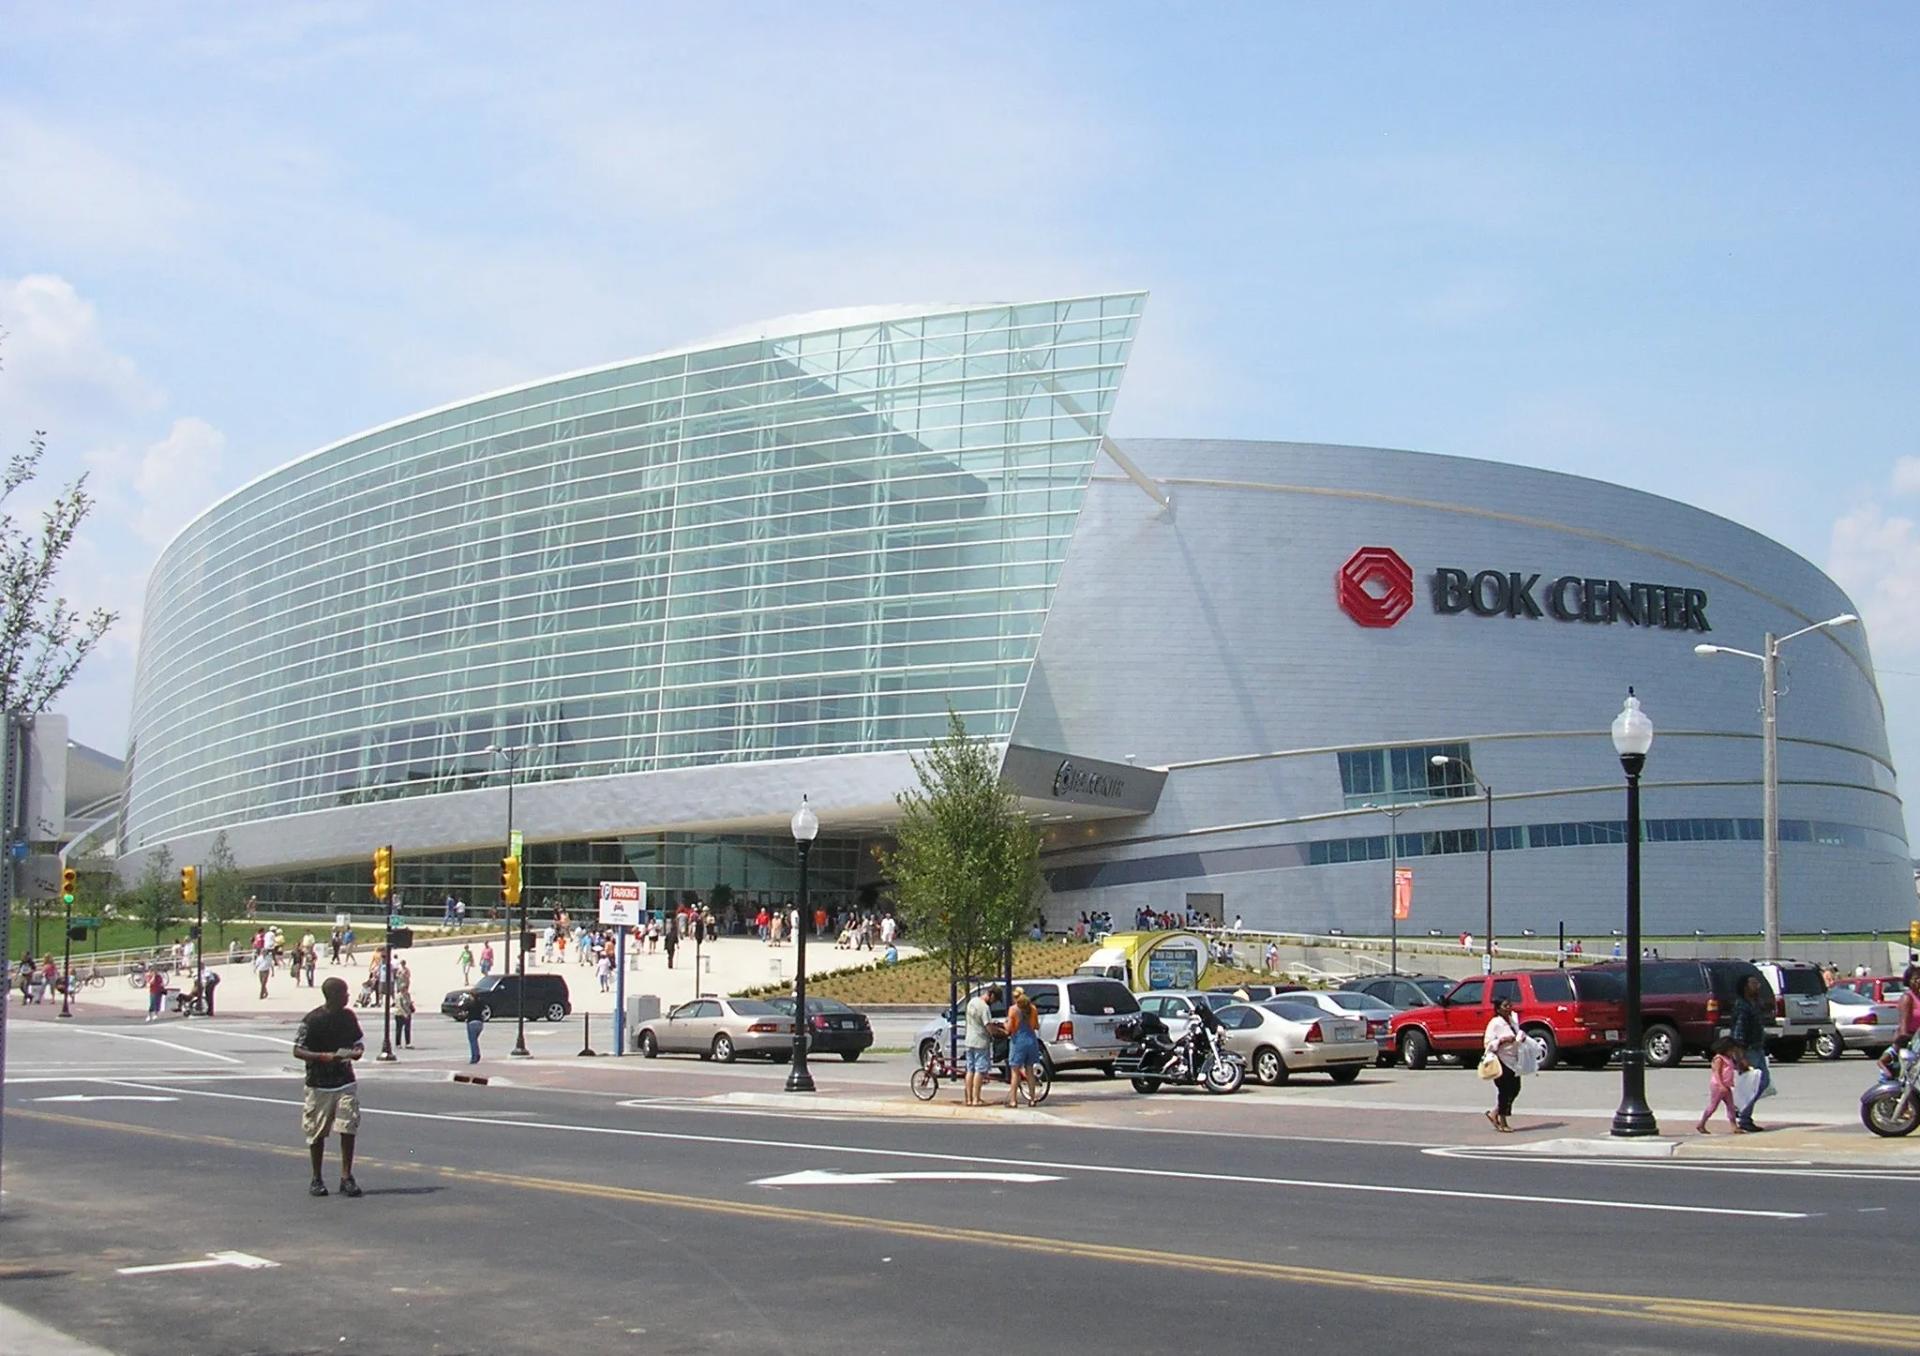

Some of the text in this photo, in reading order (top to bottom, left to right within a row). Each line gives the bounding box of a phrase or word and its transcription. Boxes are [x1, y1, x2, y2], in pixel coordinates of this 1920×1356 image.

[1434, 568, 1712, 631] BOK CENTER
[613, 887, 638, 899] PARKING
